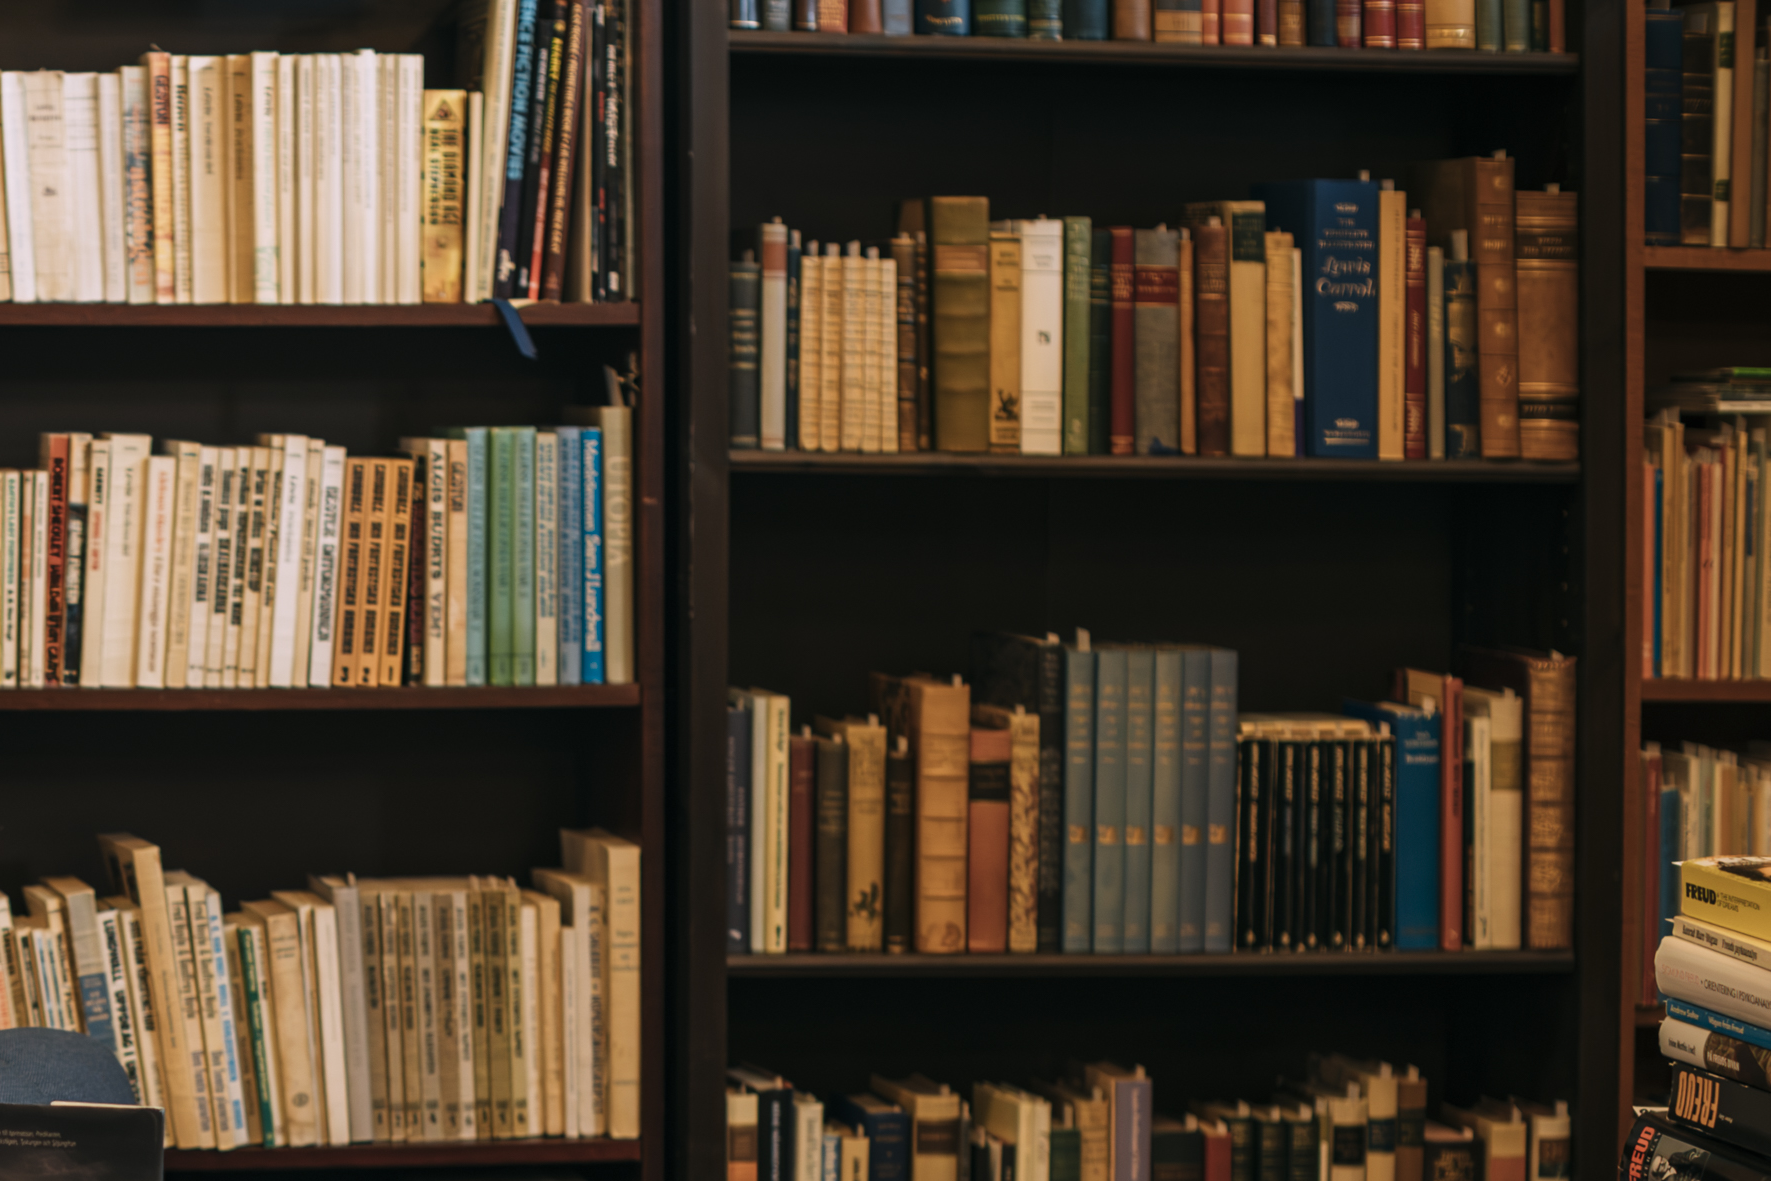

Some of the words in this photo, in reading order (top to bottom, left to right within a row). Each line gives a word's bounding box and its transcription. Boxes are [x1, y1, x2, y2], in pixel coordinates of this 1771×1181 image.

[512, 44, 534, 113] FICTION
[507, 114, 528, 181] MOVIES
[1321, 256, 1371, 278] Lewis
[52, 457, 65, 502] ROBERT
[431, 452, 443, 503] ALGIS
[608, 456, 629, 568] UTOPIA
[585, 534, 601, 569] Sam
[585, 582, 602, 652] Lundwall
[1685, 882, 1717, 905] FREUD
[1703, 978, 1736, 999] ORIENTERING
[1675, 1071, 1720, 1129] FREUD
